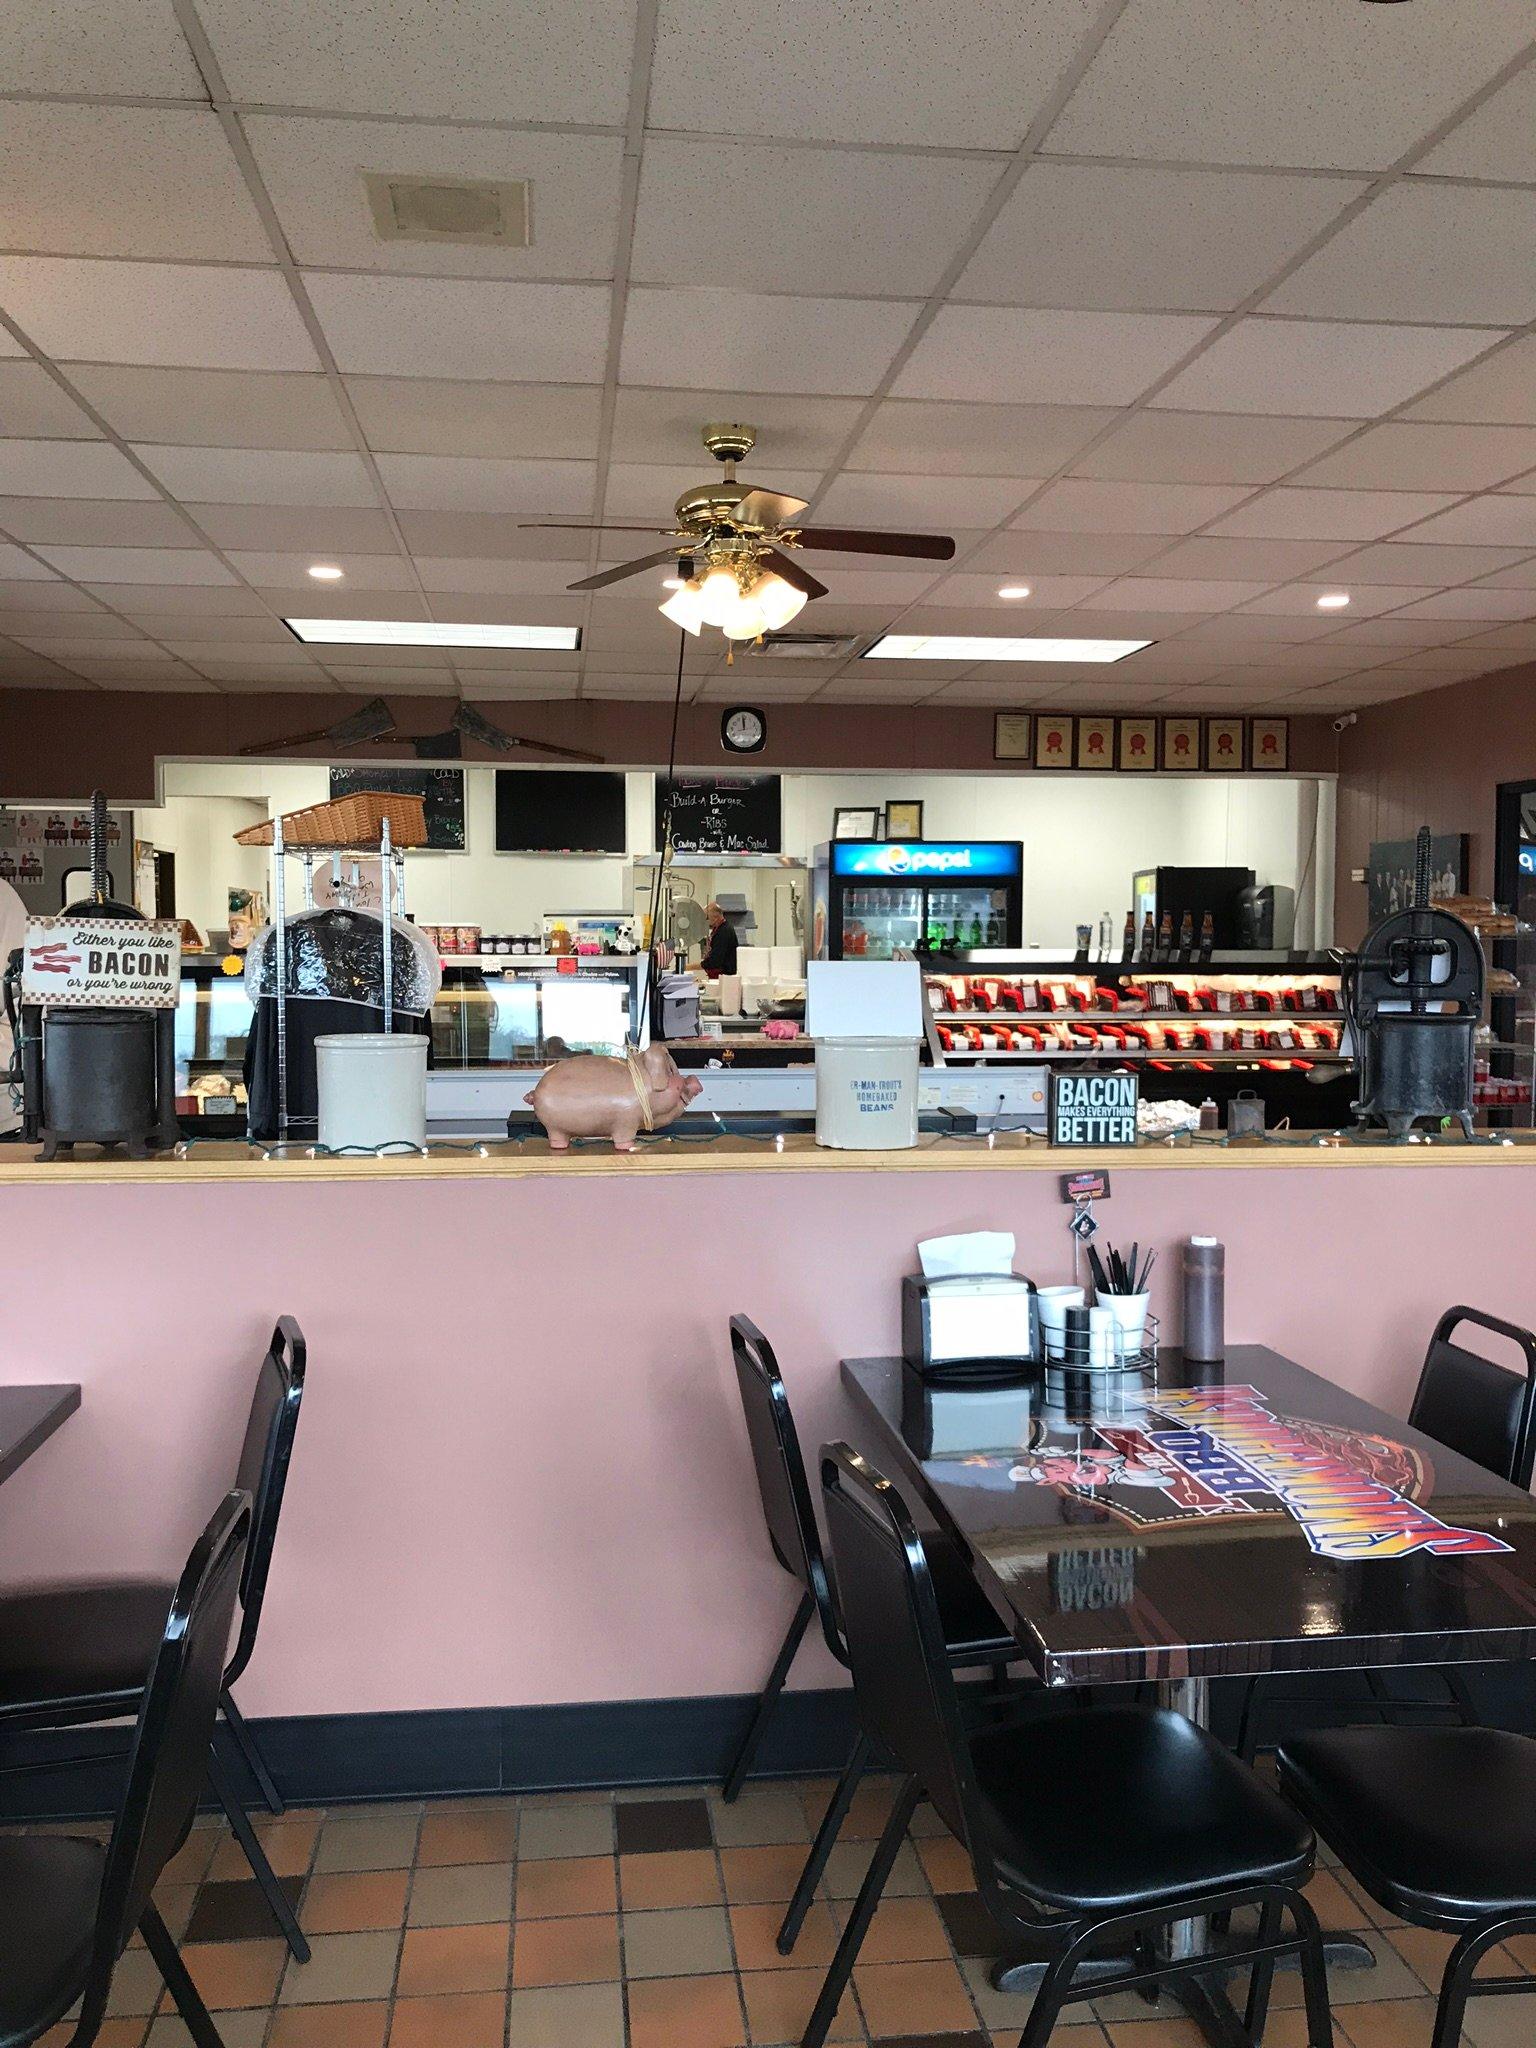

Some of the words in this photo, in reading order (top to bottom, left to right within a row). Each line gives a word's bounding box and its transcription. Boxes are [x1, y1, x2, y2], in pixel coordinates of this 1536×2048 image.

[72, 931, 117, 946] Either
[118, 937, 145, 950] you
[146, 933, 174, 949] like
[88, 951, 169, 977] BACON
[67, 977, 82, 987] or
[84, 978, 128, 991] you're
[129, 981, 173, 994] wrong
[1059, 1078, 1135, 1106] BACON
[860, 1104, 894, 1112] BEANS
[1057, 1106, 1085, 1117] MAKES
[1086, 1106, 1135, 1117] EVERYTHING
[1058, 1117, 1135, 1142] BETTER
[1112, 1384, 1516, 1560] SMOKEHOUSE
[1135, 1450, 1182, 1476] THE
[1147, 1429, 1277, 1497] BBQ
